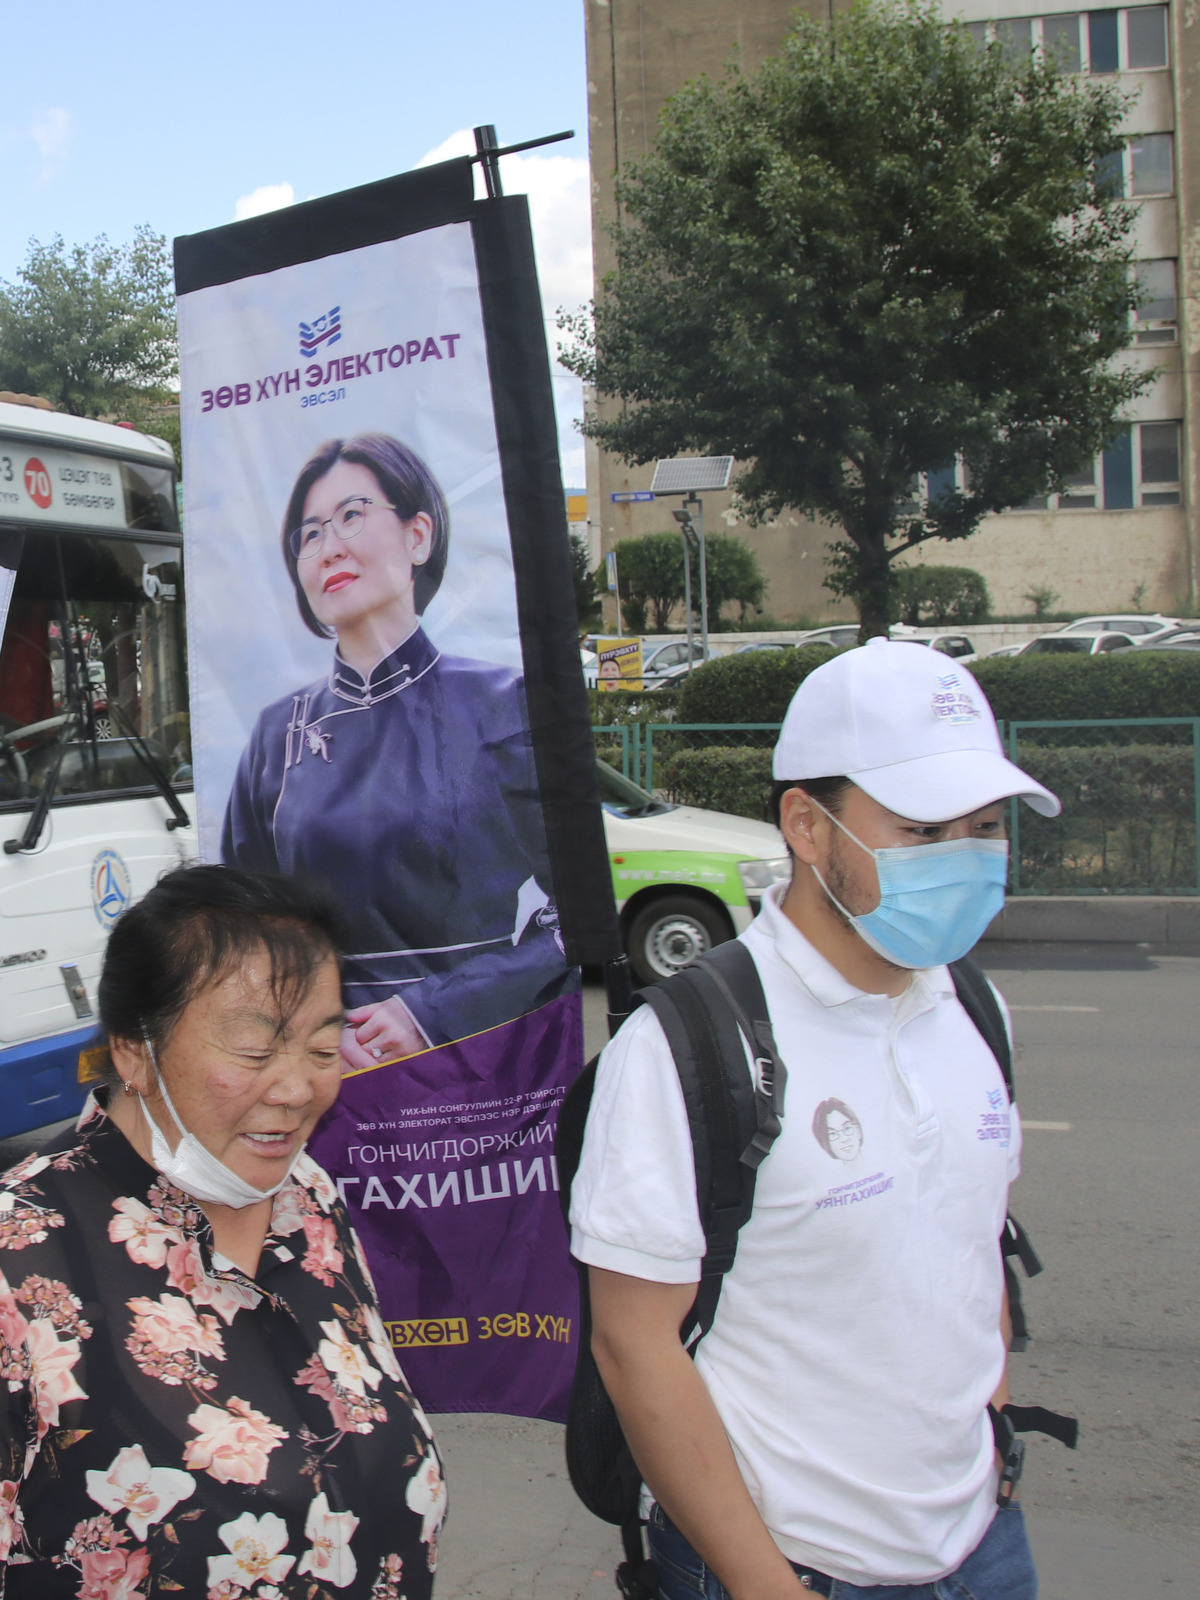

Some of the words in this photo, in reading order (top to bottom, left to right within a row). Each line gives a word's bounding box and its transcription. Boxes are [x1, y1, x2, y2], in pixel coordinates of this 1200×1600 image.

[201, 383, 251, 413] ЗӨВ
[256, 368, 300, 402] ХҮН
[305, 333, 461, 388] ЭЛЕКТОРАТ
[300, 387, 346, 408] ЭВСЭЛ
[25, 470, 50, 497] 70
[357, 1122, 377, 1131] ЗӨВ
[378, 1120, 396, 1131] ХҮН
[398, 1116, 453, 1129] ЭЛЕКТОРАТ
[454, 1110, 500, 1124] ЭВСЛЭЭС
[502, 1107, 521, 1118] НЭР
[522, 1099, 564, 1115] ДЭВШИГ
[400, 1105, 437, 1117] УИХ-ЫН
[439, 1098, 502, 1114] СОНГУУЛИЙН
[504, 1094, 523, 1107] 22-Р
[524, 1085, 567, 1101] ТОЙРОГТ
[347, 1120, 557, 1165] ГОНЧИГДОРЖИЙ
[336, 1155, 560, 1210] ГАХИШИ
[534, 1313, 571, 1344] ХҮН
